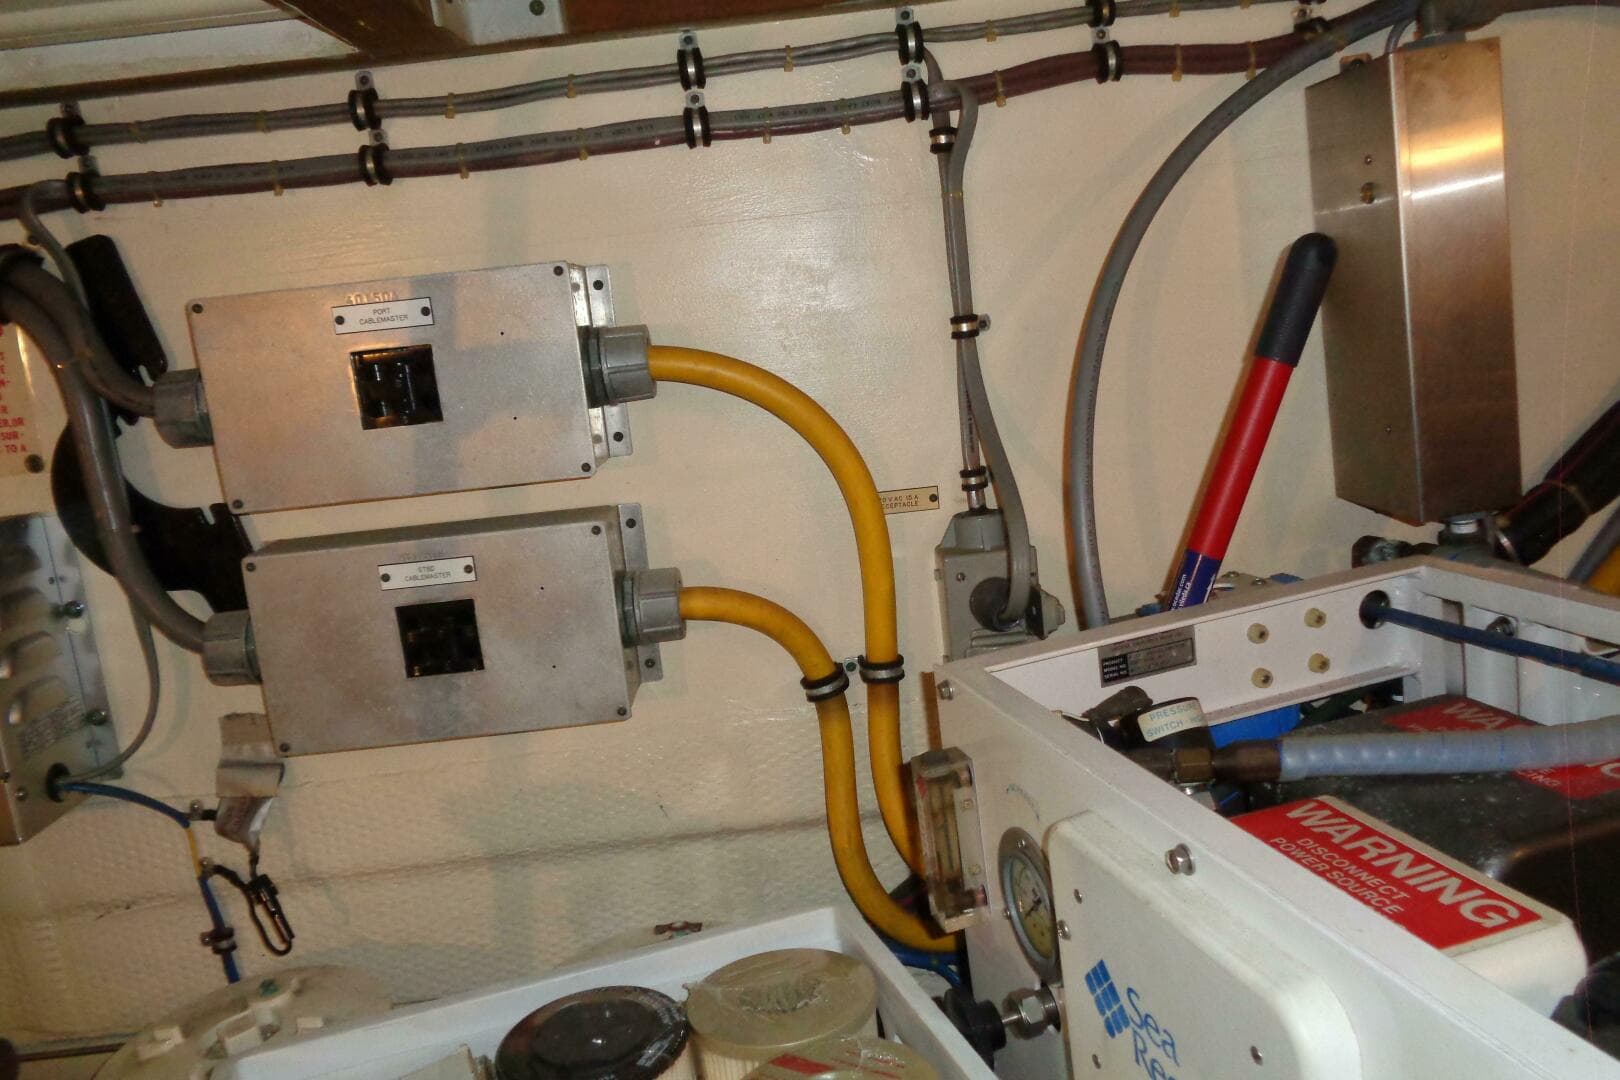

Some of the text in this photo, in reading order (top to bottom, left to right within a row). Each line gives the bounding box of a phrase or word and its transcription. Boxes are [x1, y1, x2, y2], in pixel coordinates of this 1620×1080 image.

[359, 314, 409, 325] CABLEMASTER
[372, 307, 391, 316] PORT
[404, 571, 452, 582] CABLEMASTER
[1145, 719, 1185, 737] SWITCH
[1269, 836, 1405, 915] POWER SOURCE
[1286, 801, 1521, 929] WARNING
[1296, 837, 1411, 900] DISCONNECT
[1126, 986, 1181, 1068] Sea
[1132, 1027, 1177, 1080] Re
